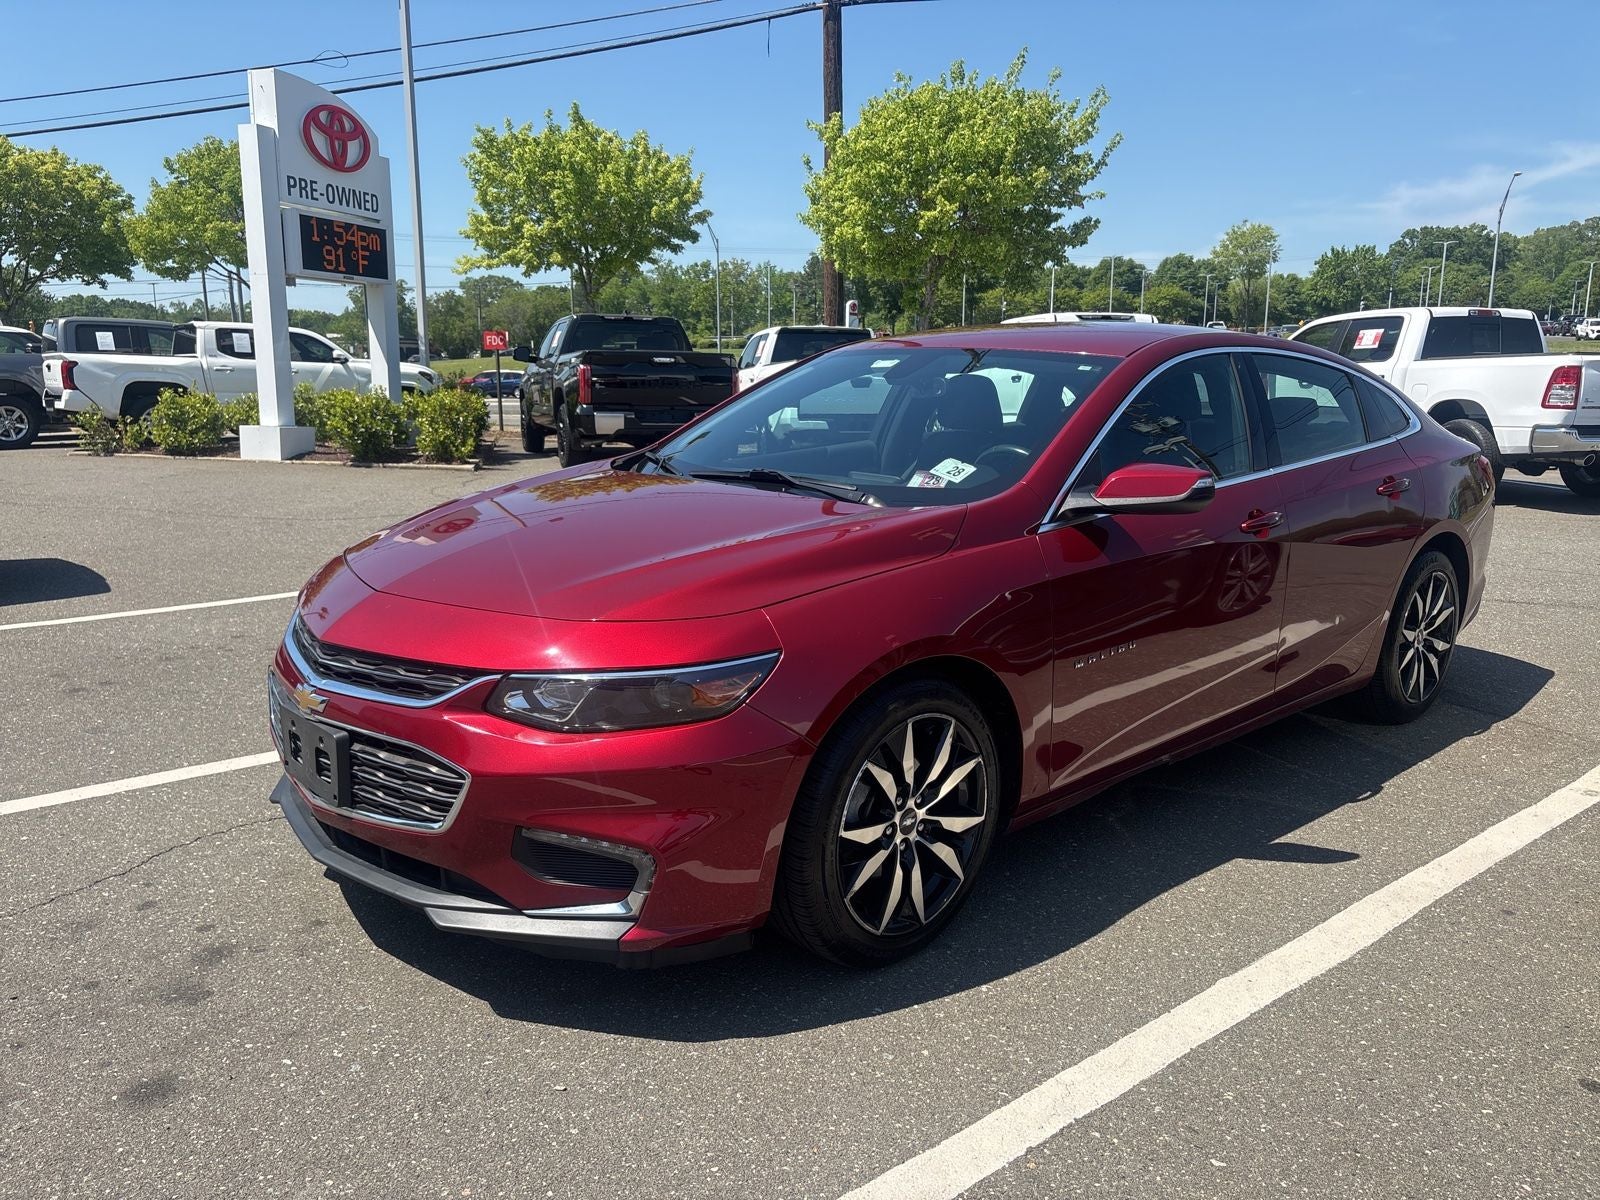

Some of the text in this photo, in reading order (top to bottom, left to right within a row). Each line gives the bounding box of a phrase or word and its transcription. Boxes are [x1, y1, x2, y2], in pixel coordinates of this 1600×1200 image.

[286, 175, 379, 213] PRE-OWNED
[310, 217, 380, 251] 1:54pm
[486, 335, 504, 346] FDC
[946, 465, 966, 477] 28
[923, 475, 942, 486] 28
